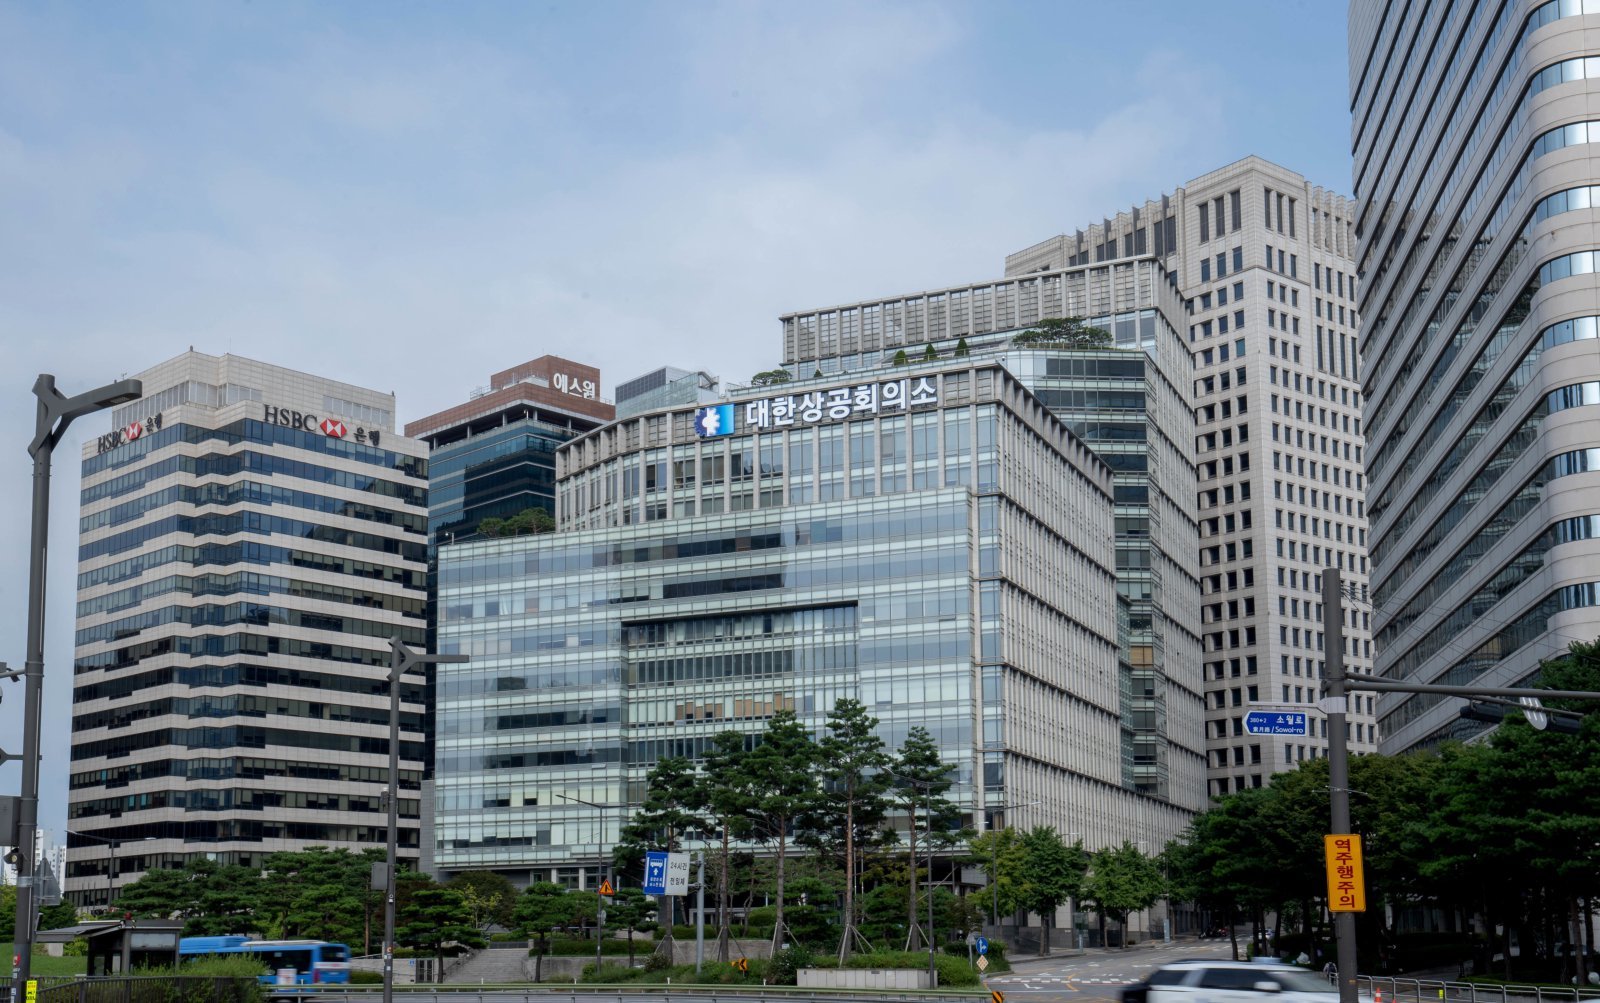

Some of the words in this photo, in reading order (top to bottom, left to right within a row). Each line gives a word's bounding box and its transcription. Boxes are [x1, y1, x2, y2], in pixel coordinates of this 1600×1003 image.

[553, 373, 596, 401] 에스원
[746, 377, 938, 428] 대한상공회의소
[264, 404, 318, 432] HSBC
[354, 426, 380, 446] 은행
[97, 427, 127, 453] HSBC
[1276, 714, 1304, 725] 소월로
[670, 861, 688, 871] 24시간
[1335, 839, 1355, 908] 역주행주의
